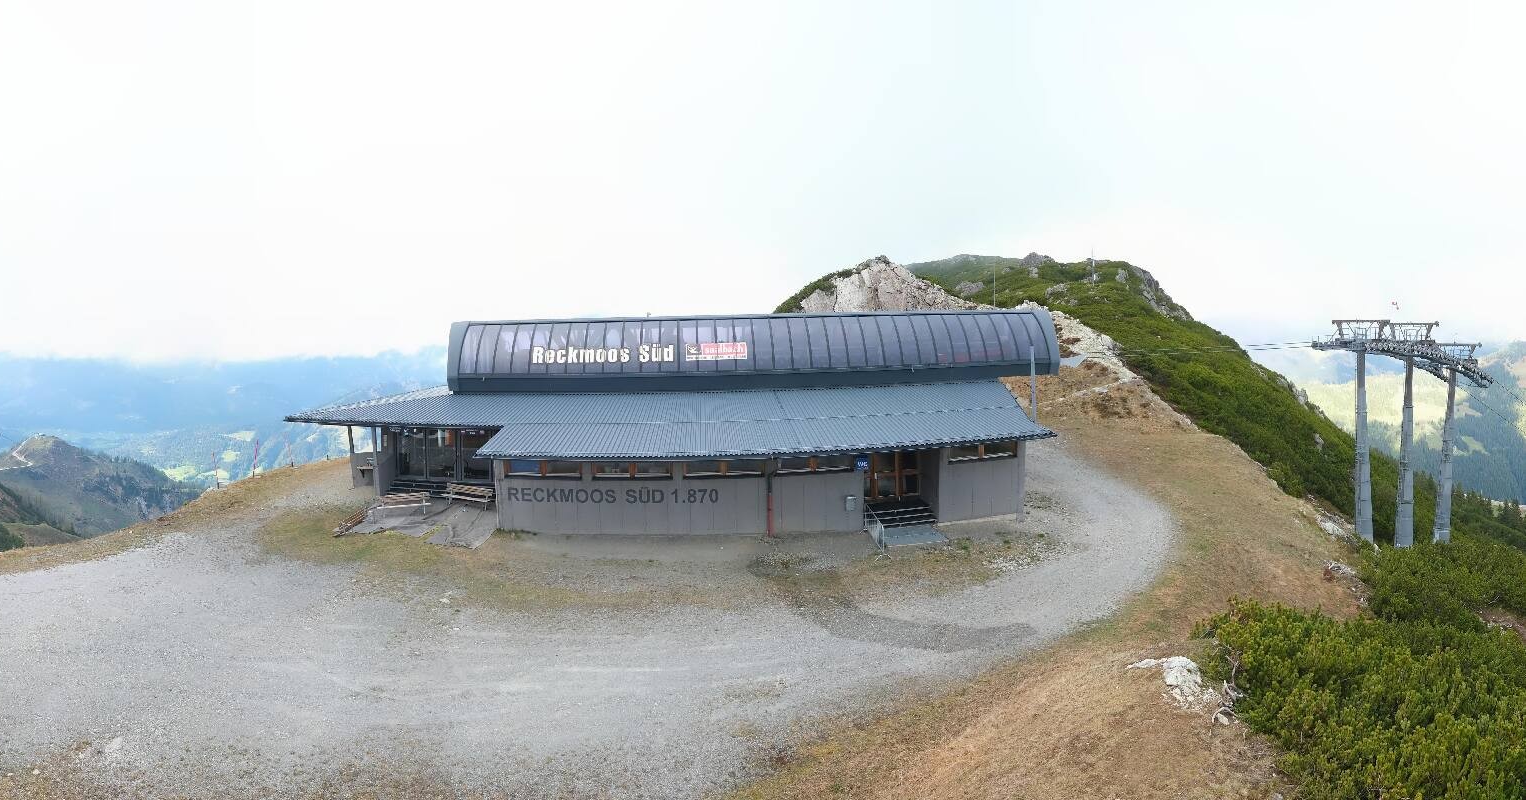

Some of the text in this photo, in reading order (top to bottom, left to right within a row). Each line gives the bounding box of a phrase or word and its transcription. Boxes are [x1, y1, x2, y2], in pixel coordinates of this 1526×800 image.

[532, 343, 674, 364] Reckmoos Süd
[507, 486, 720, 504] RECKMOOS SÜD 1.870
